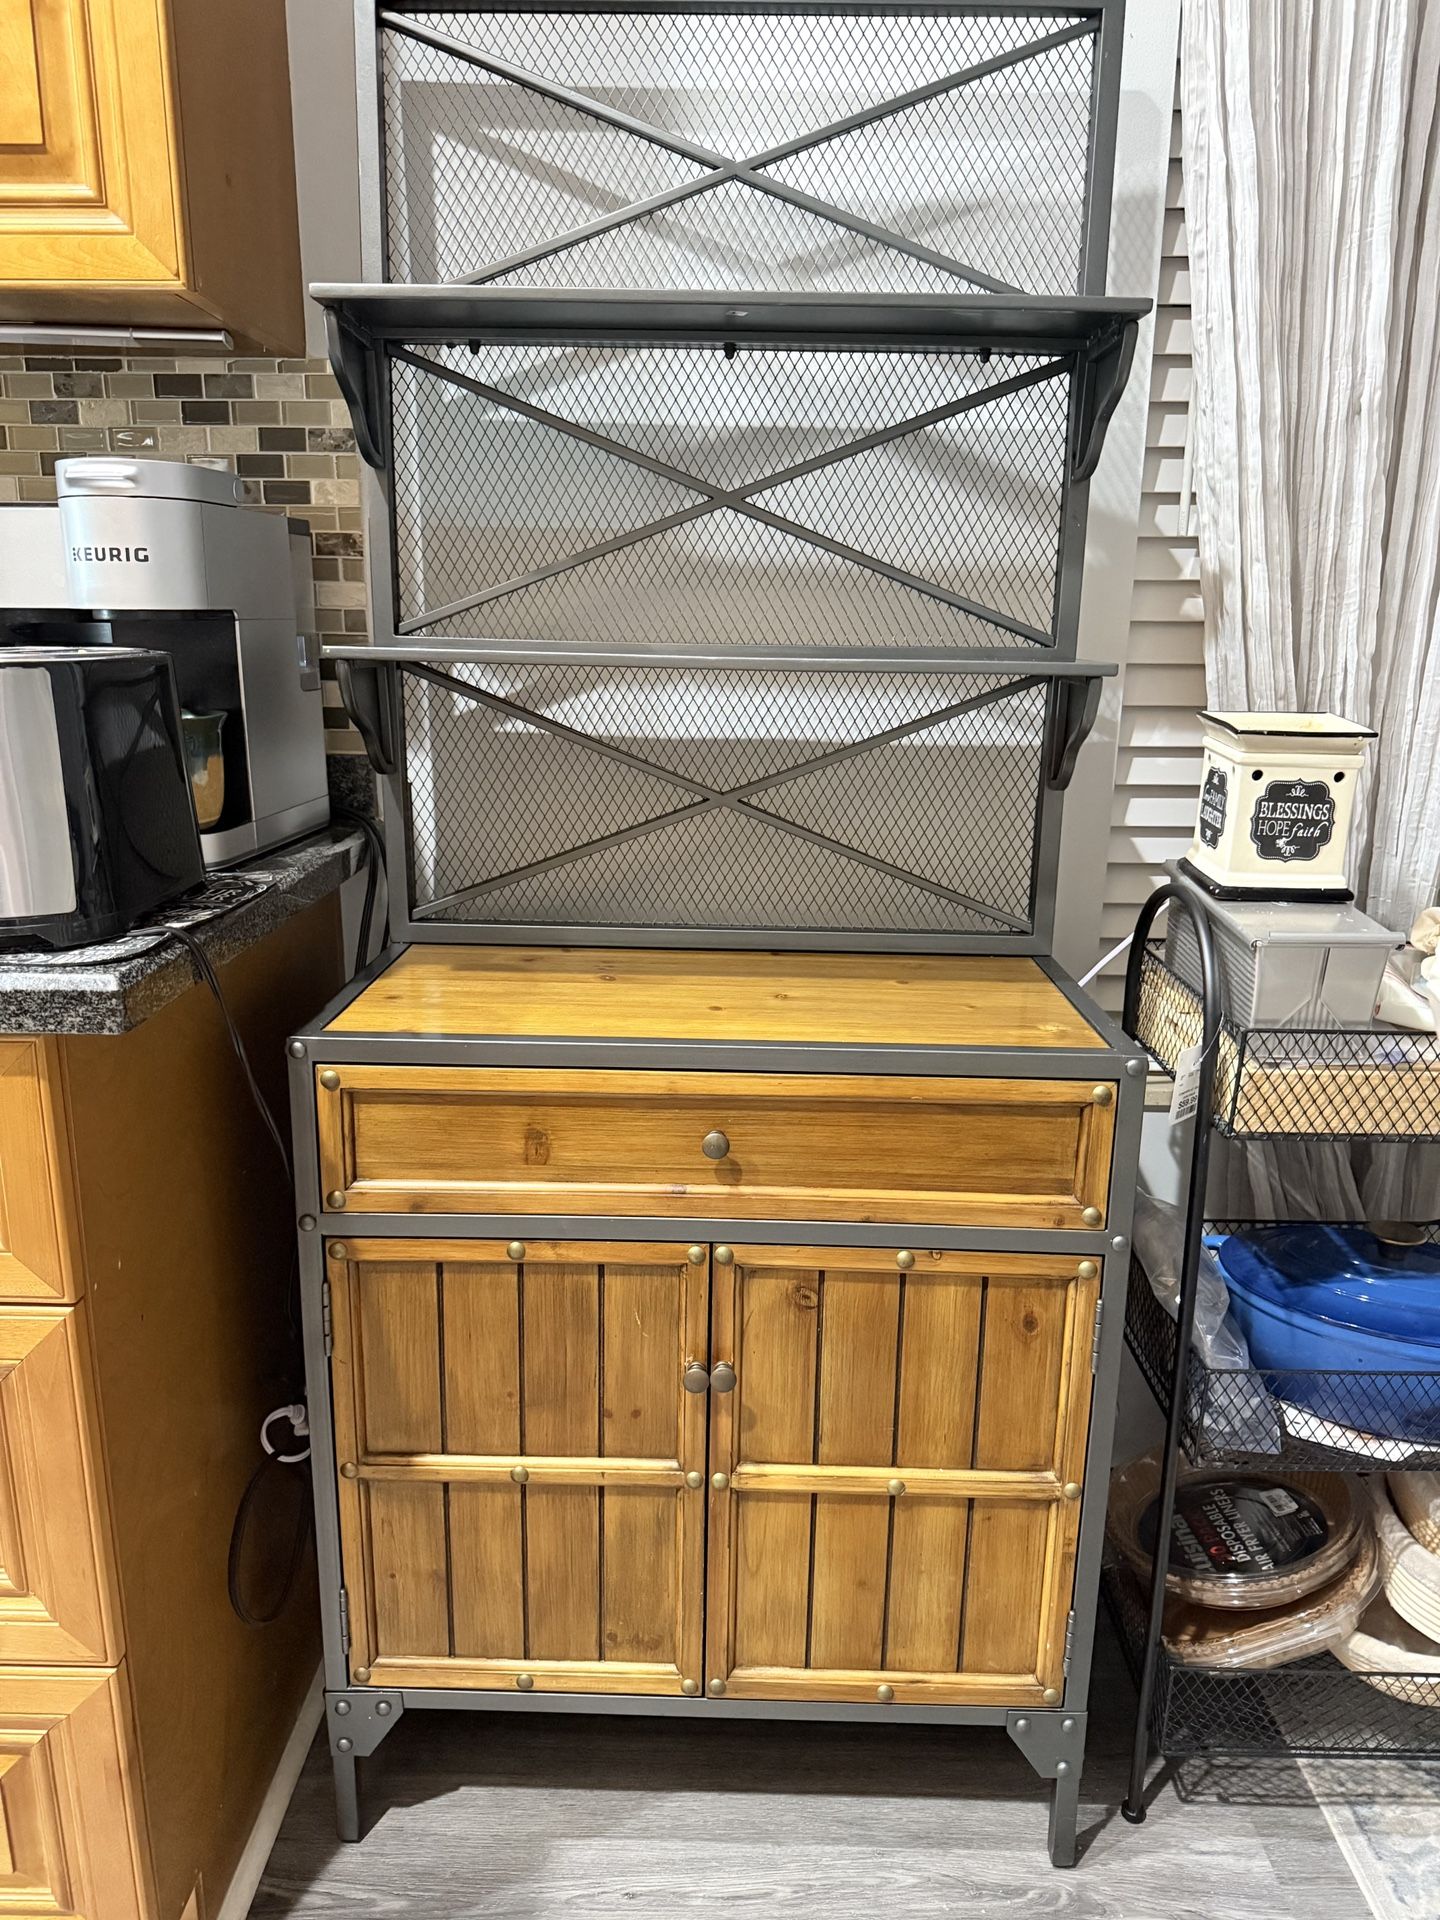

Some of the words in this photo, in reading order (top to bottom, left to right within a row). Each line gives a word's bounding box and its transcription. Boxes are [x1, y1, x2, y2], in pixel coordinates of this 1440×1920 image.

[72, 547, 149, 562] KEURIG
[1258, 801, 1330, 820] BLESSINGS
[1257, 820, 1291, 837] HOPE
[1286, 821, 1329, 841] faith
[1210, 1487, 1240, 1521] LINERS
[1172, 1503, 1217, 1573] uisina
[1202, 1503, 1251, 1563] DISPOSABLE
[1232, 1520, 1264, 1553] FRYER
[1255, 1549, 1275, 1571] AIR
